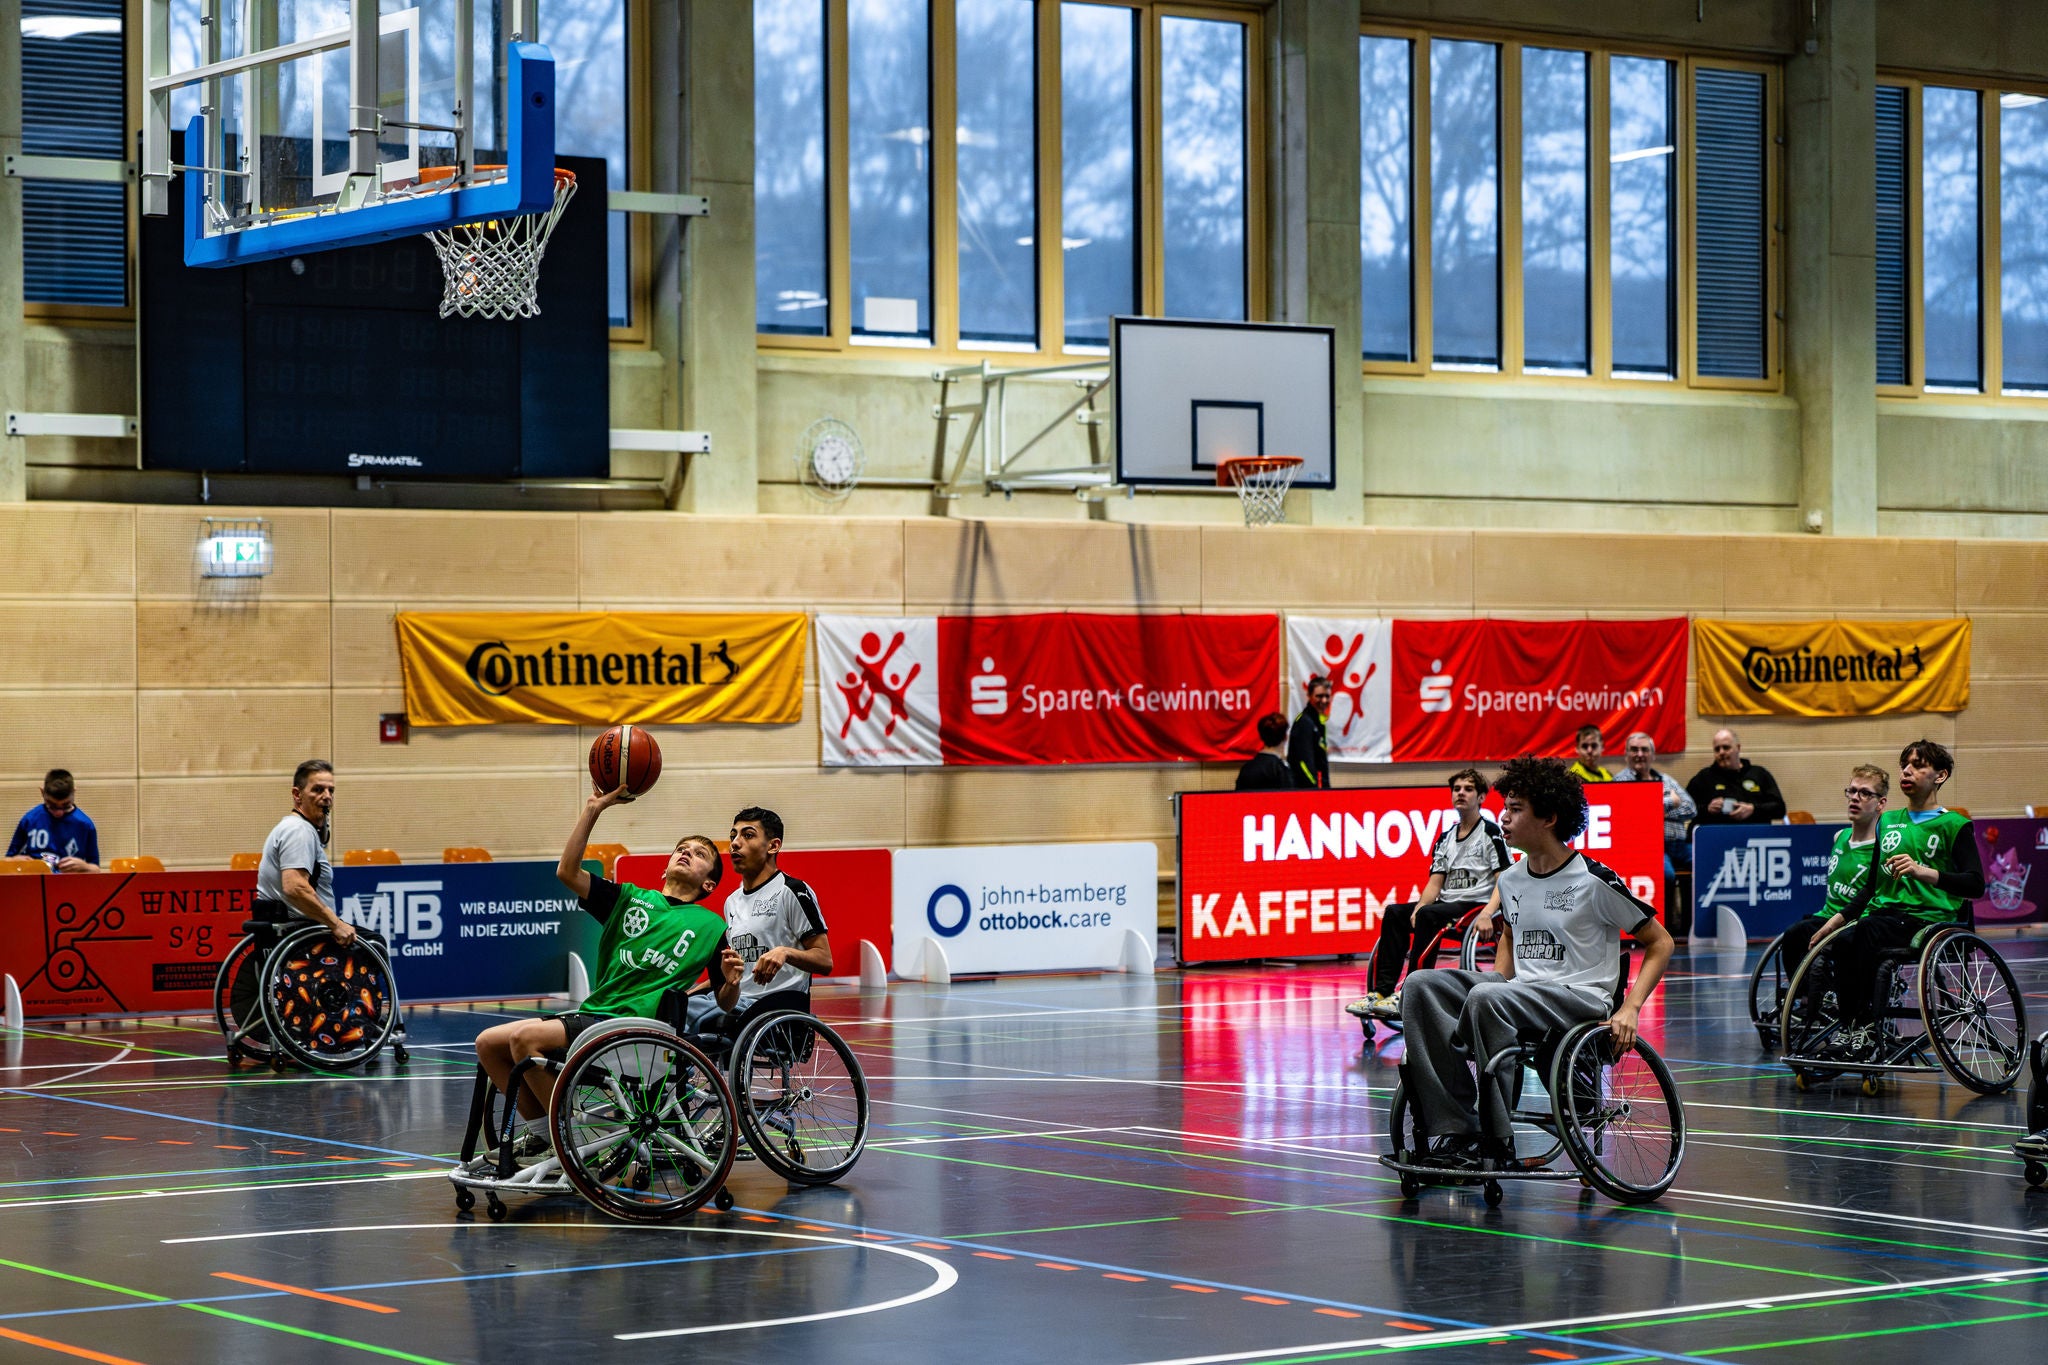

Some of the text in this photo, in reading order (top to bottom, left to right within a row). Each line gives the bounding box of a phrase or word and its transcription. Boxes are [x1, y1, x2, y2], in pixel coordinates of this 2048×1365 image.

[465, 641, 706, 696] Continental
[1742, 645, 1904, 693] Continental
[27, 828, 49, 849] 10
[1924, 834, 1940, 859] 9
[1802, 856, 1819, 868] WIR
[1701, 838, 1792, 908] MTB
[1802, 875, 1812, 887] IN
[1850, 864, 1868, 884] 7
[979, 882, 1128, 911] john+bamberg
[1763, 889, 1792, 901] GmbH
[1833, 881, 1858, 899] EWE
[460, 902, 486, 915] WIR
[488, 900, 533, 914] BAUEN
[535, 899, 562, 913] DEN
[338, 881, 443, 957] MTB
[979, 910, 1112, 931] ottobock.care
[1510, 912, 1519, 926] 37
[460, 921, 561, 938] IN DIE ZUKUNFT
[1522, 929, 1554, 945] EURO
[402, 942, 444, 957] GmbH
[672, 929, 696, 958] 6
[641, 947, 680, 976] EWE
